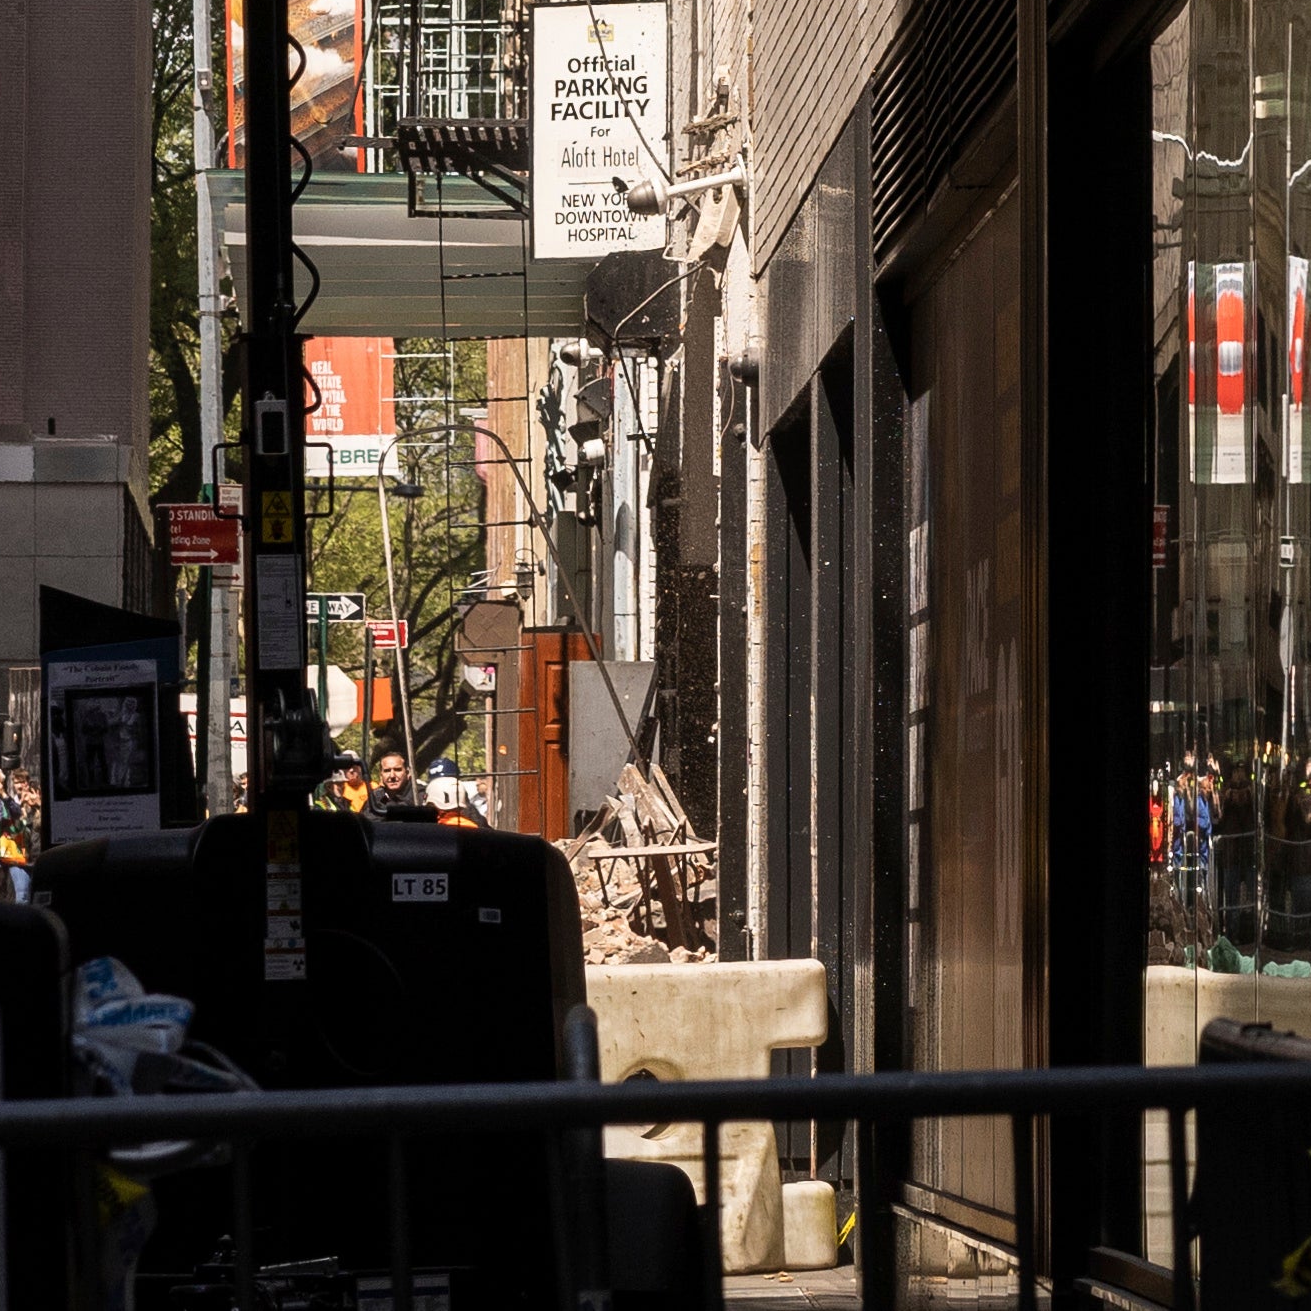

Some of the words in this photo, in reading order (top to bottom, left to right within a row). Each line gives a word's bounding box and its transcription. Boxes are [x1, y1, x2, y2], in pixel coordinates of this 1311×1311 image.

[568, 55, 635, 73] Official
[555, 76, 647, 97] PARKING
[551, 99, 650, 121] FACILITY
[590, 126, 610, 137] For
[561, 147, 595, 167] Aloft
[603, 145, 639, 167] Hotel
[562, 194, 595, 207] NEW
[568, 227, 637, 242] HOSPITAL
[311, 360, 334, 375] REAL
[326, 404, 341, 417] THE
[312, 418, 344, 431] WORLD
[326, 449, 380, 464] CBRE
[328, 603, 352, 614] WAY
[394, 879, 416, 895] LT
[423, 879, 446, 895] 85
